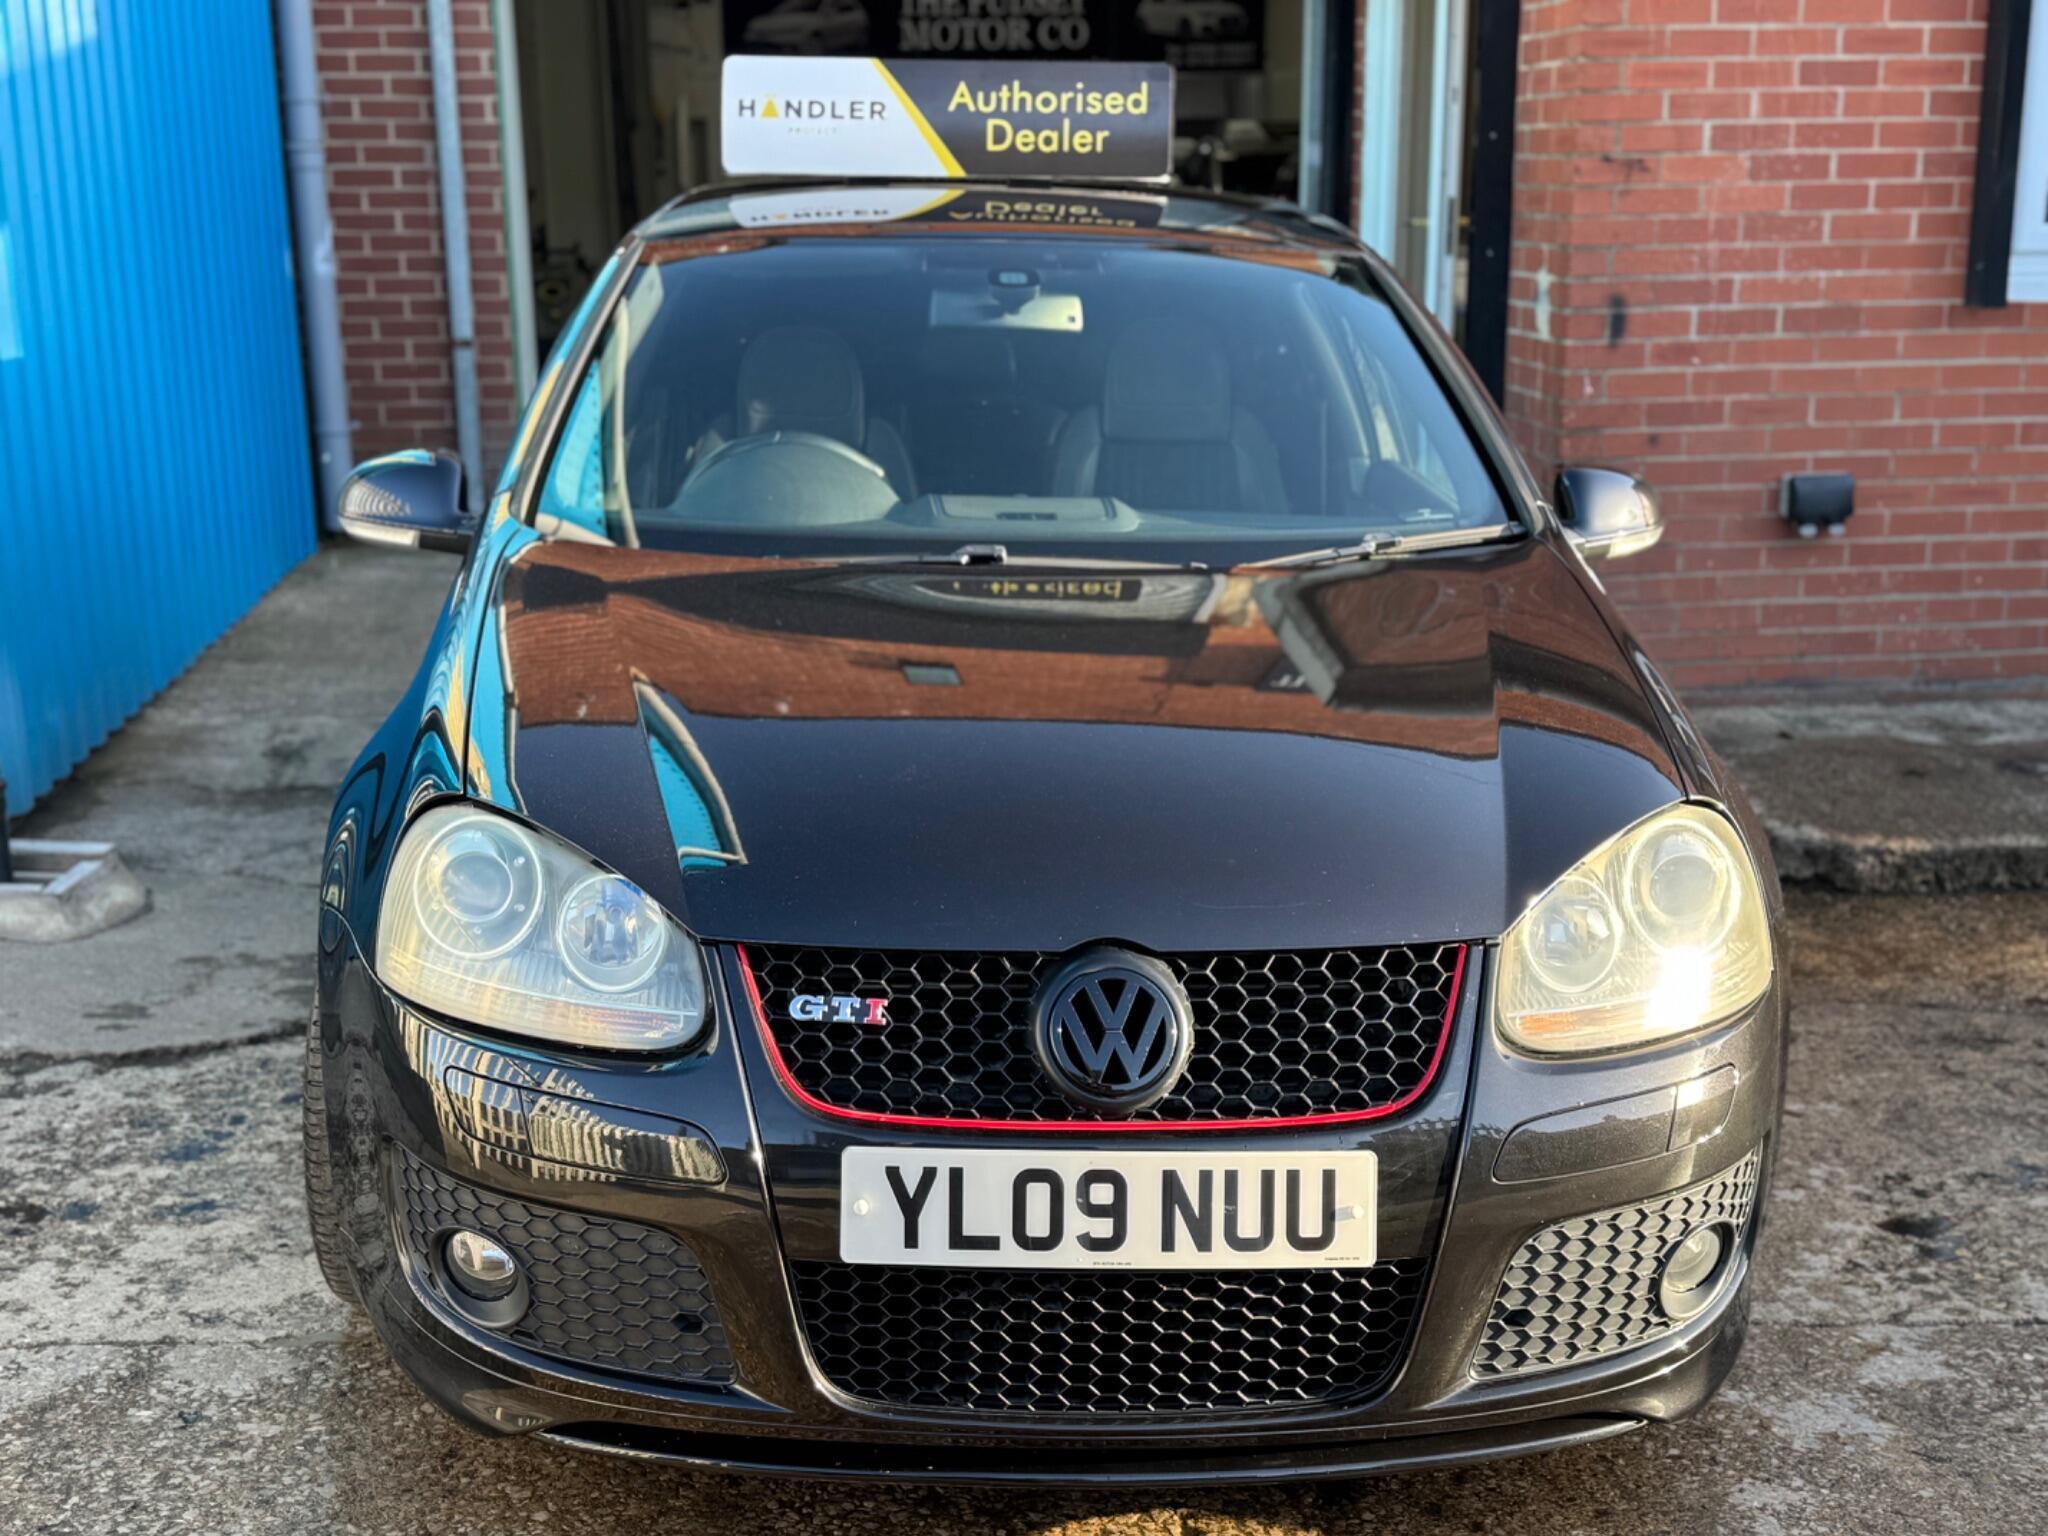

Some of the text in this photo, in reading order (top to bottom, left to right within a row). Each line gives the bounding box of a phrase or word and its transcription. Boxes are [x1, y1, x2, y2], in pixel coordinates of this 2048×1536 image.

[899, 17, 1090, 50] MOTOR CO
[947, 80, 1149, 114] Authorised
[986, 118, 1110, 153] Dealer
[789, 995, 889, 1025] GTI
[884, 1166, 1336, 1253] YL09 NUU
